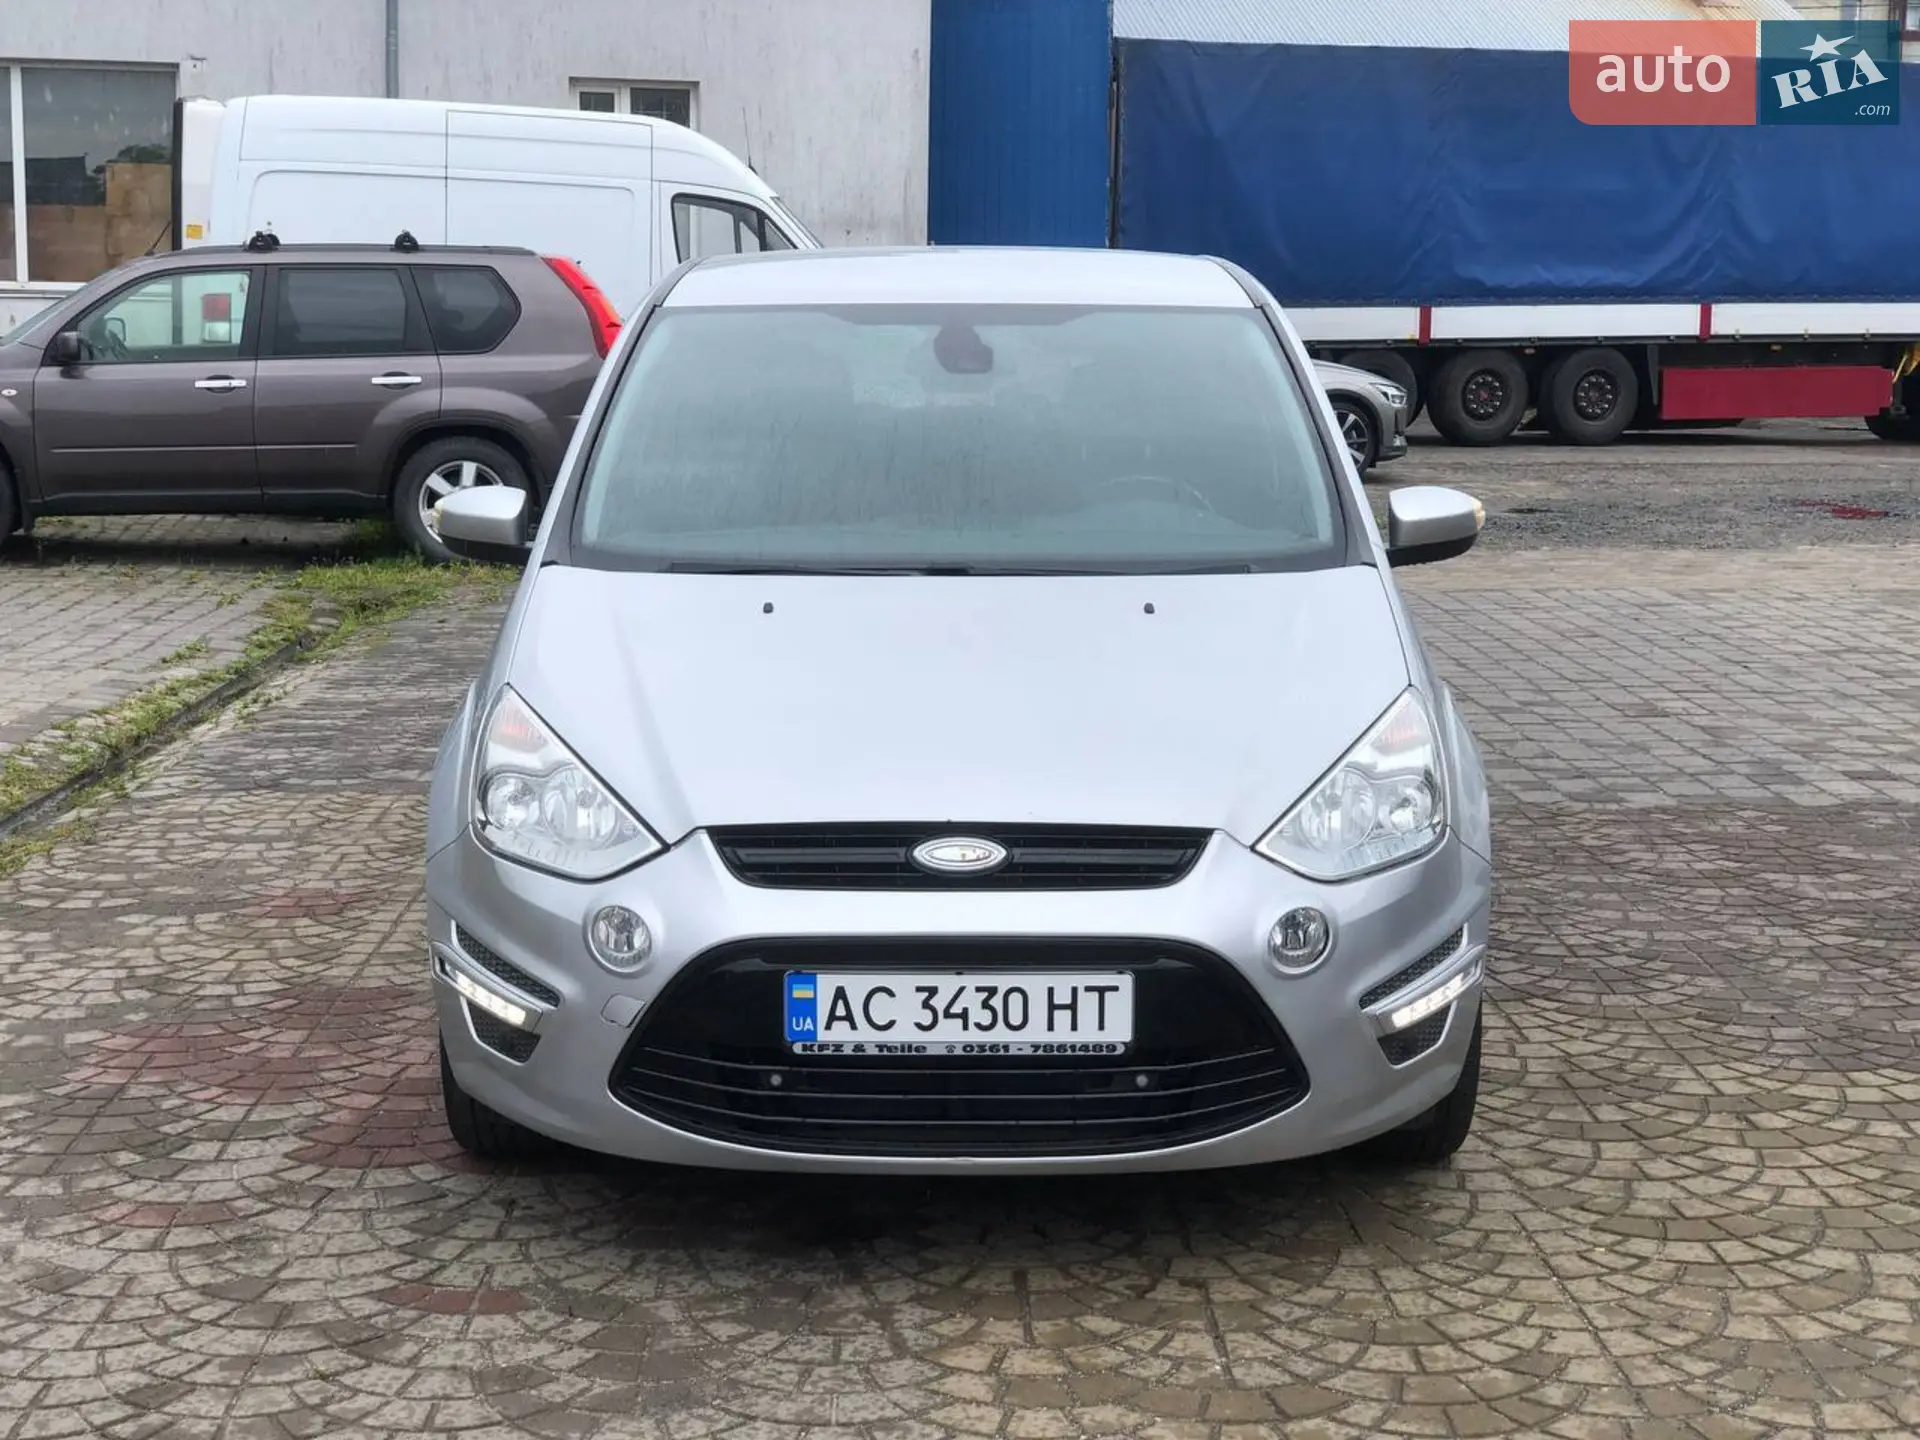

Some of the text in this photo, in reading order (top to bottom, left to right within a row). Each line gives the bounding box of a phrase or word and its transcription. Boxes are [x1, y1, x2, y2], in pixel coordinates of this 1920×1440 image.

[824, 985, 1119, 1032] AC 3430 HT
[792, 1016, 814, 1031] UA
[801, 1043, 844, 1053] KFZ
[851, 1043, 866, 1053] &
[875, 1043, 927, 1053] Teile
[962, 1043, 1011, 1053] 0361
